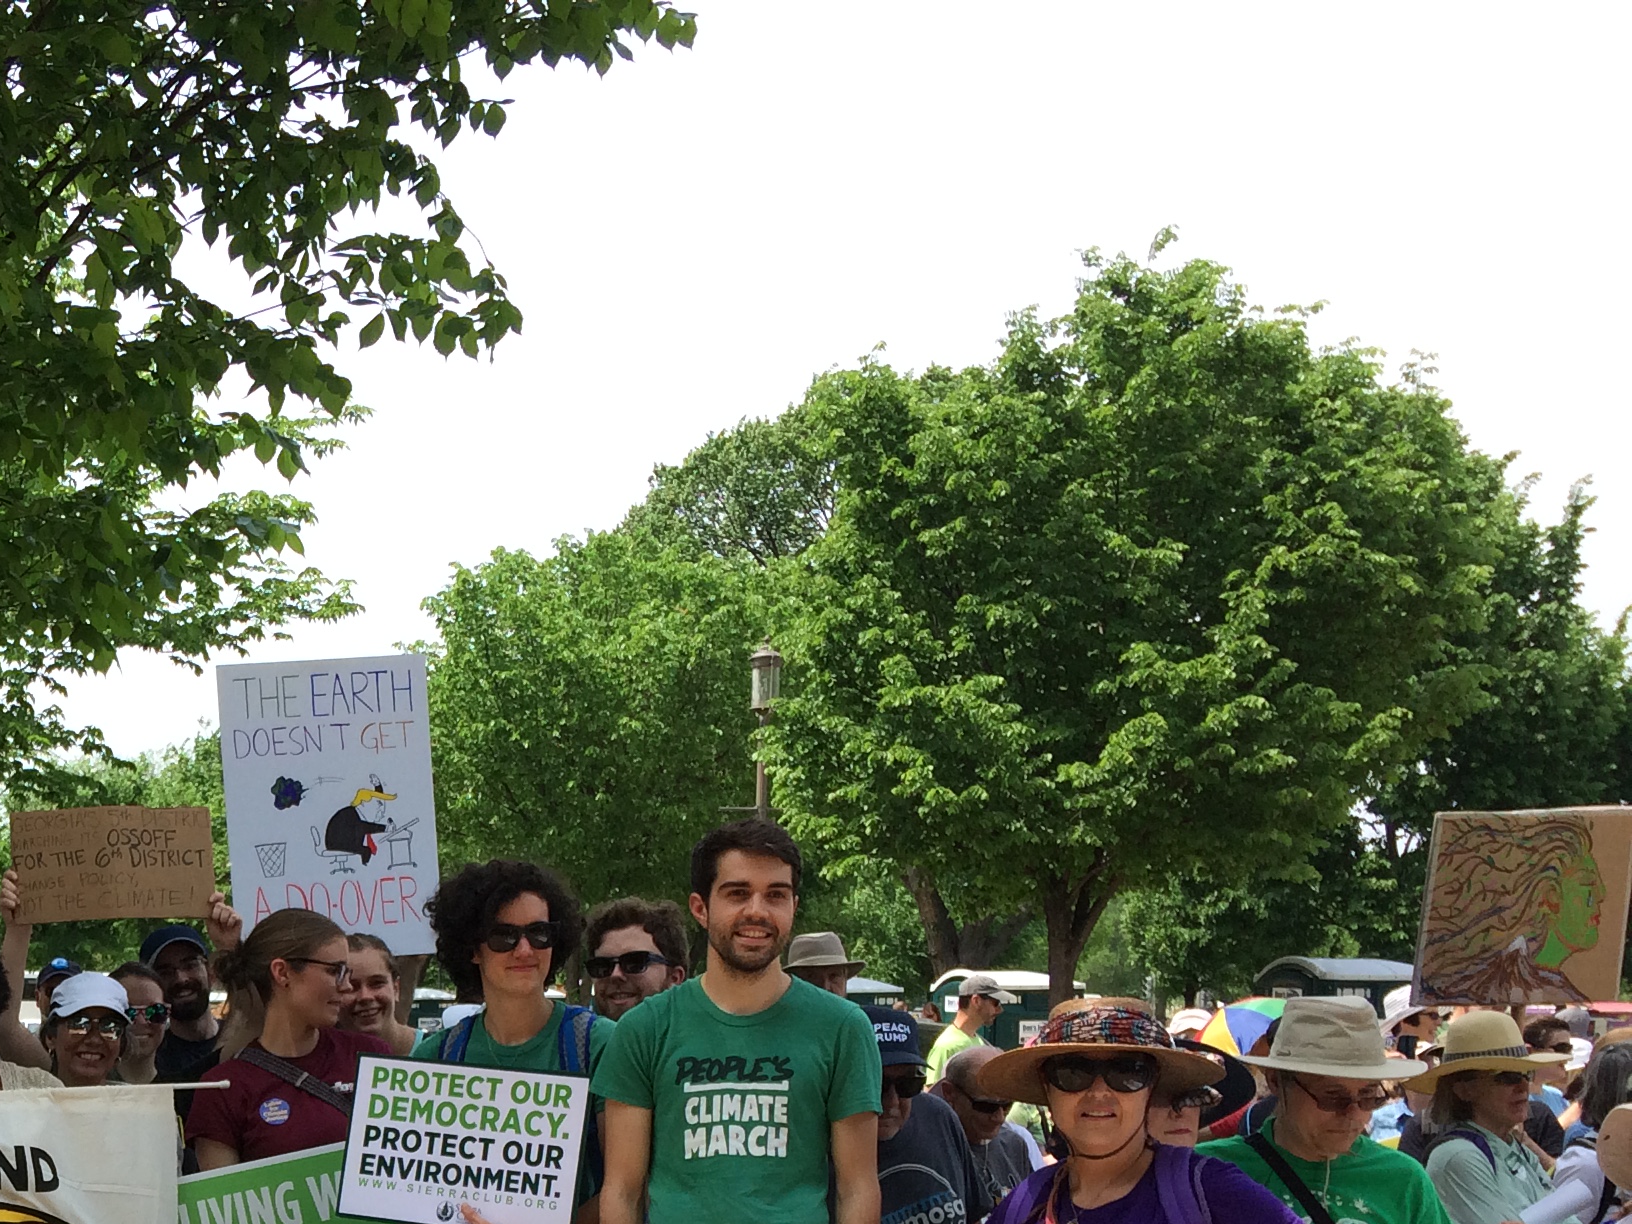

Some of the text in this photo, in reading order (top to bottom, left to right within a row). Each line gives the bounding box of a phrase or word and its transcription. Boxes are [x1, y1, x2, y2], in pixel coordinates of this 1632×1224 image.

[232, 670, 414, 719] THE EARTH
[233, 720, 414, 759] DOESN'T GET
[107, 829, 176, 848] OSSOFF
[13, 846, 205, 872] FOR THE 6th DISTRICT
[53, 892, 87, 910] THE
[255, 886, 274, 925] A
[874, 1023, 911, 1034] PEACH
[875, 1033, 908, 1042] RUMP
[371, 1066, 572, 1109] PROTECT OUR
[675, 1056, 794, 1085] PEOPLE'S
[368, 1094, 570, 1140] DEMOCRACY.
[685, 1094, 788, 1124] CLIMATE
[363, 1124, 564, 1170] PROTECT OUR
[684, 1125, 788, 1160] MARCH
[359, 1153, 561, 1199] ENVIRONMENT.
[358, 1177, 558, 1211] WWW.SIERRACLUB.ORG
